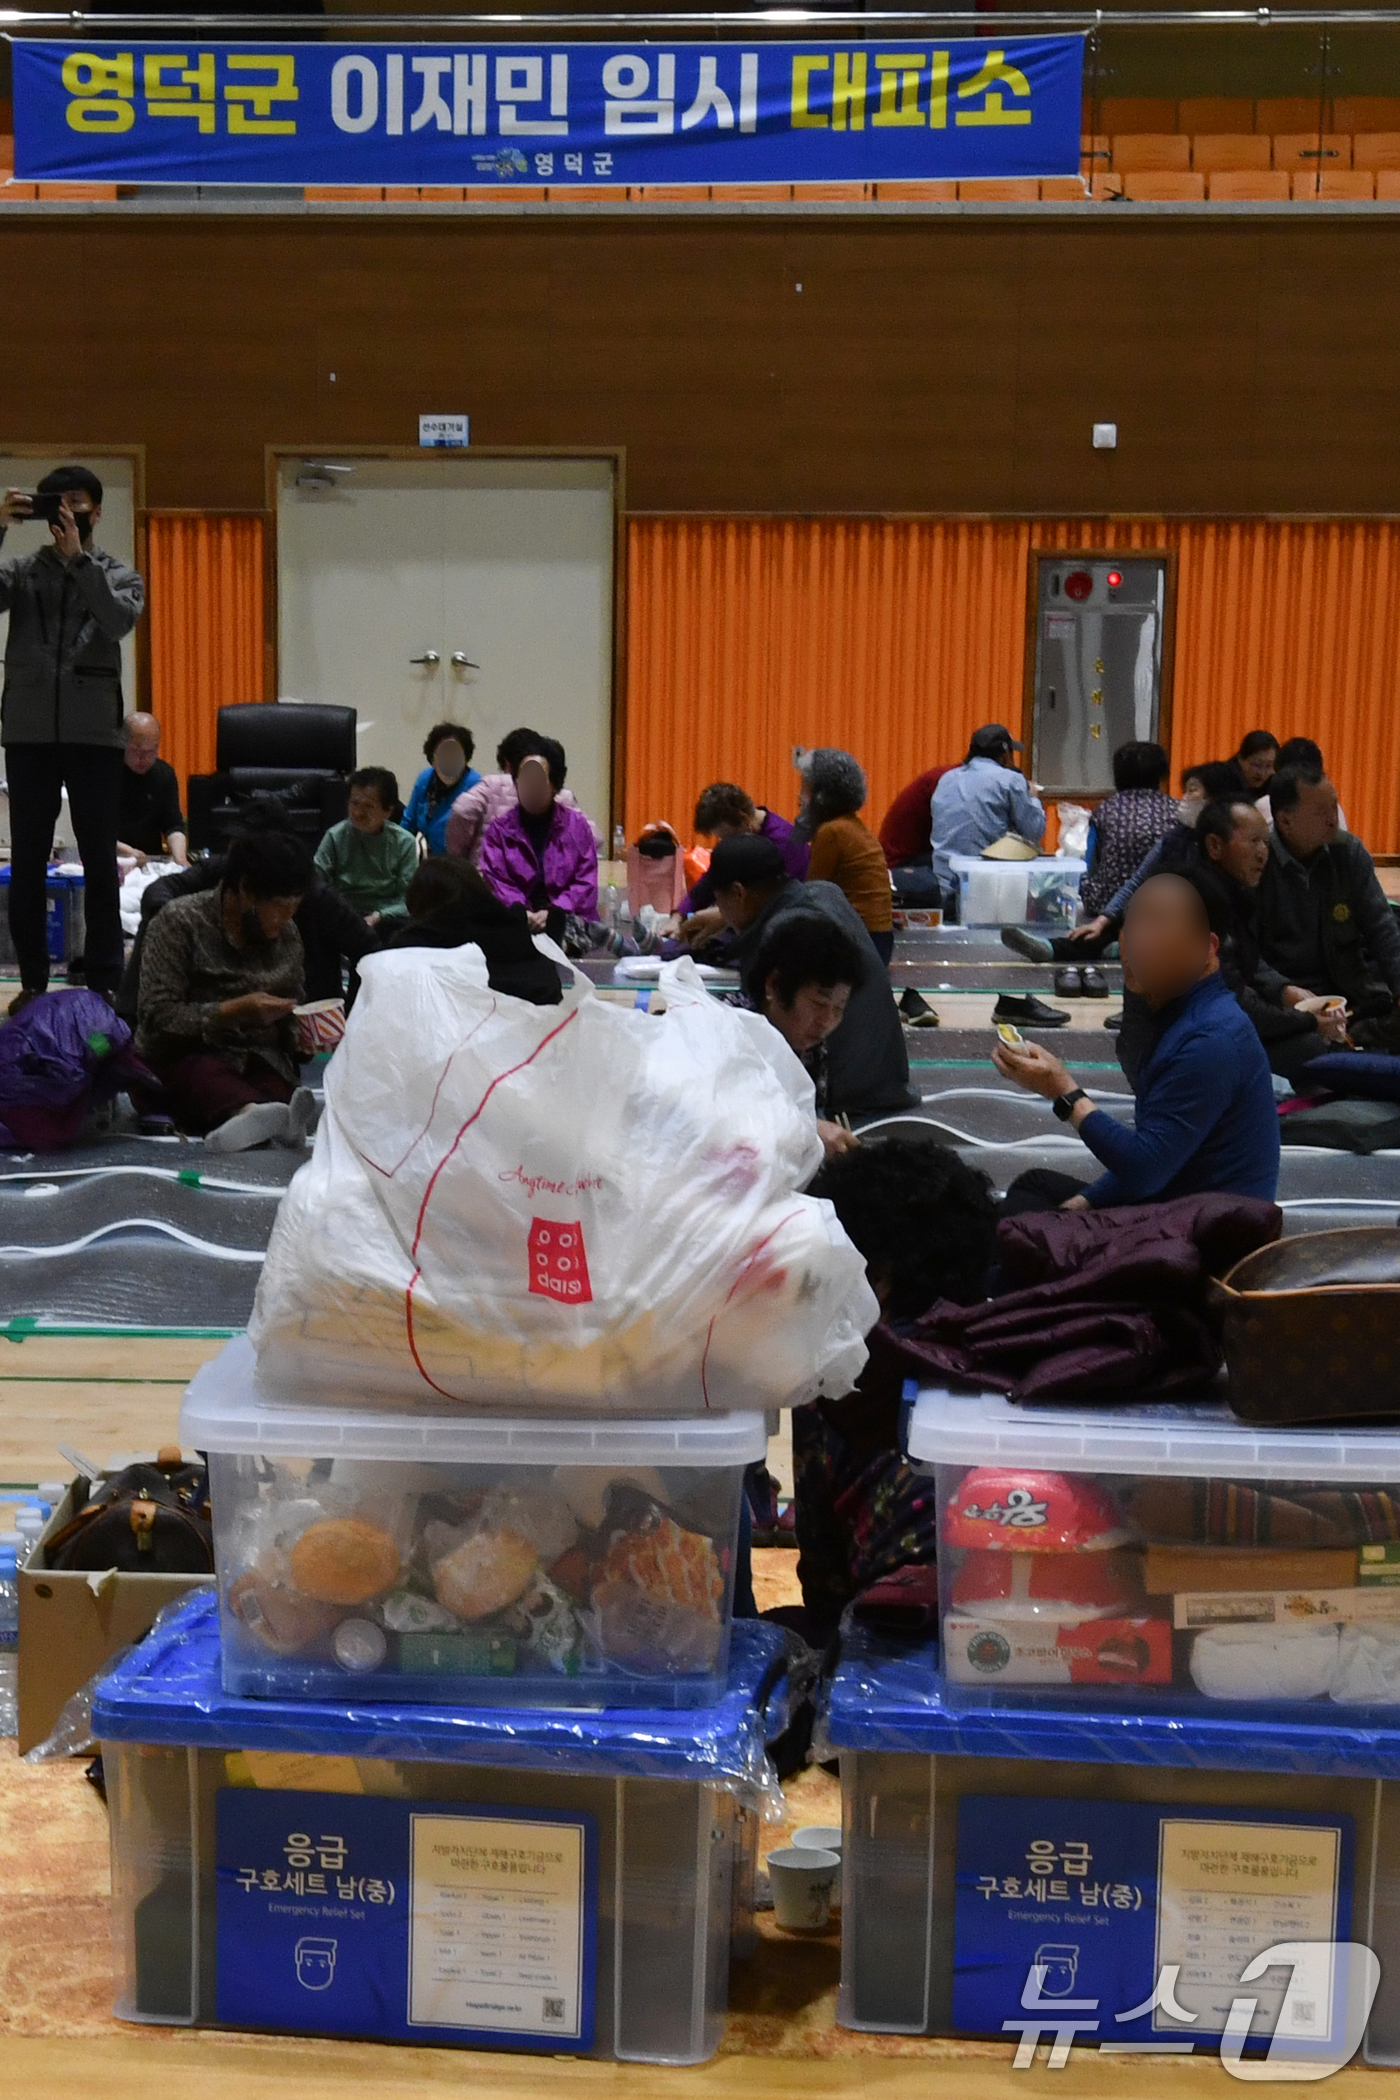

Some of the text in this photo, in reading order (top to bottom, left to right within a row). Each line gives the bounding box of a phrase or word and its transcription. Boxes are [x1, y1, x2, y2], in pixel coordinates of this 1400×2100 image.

[61, 50, 1032, 136] 영덕군 이재민 임시 대피소
[534, 152, 614, 176] 영덕군
[283, 1832, 349, 1870] 응급
[1025, 1839, 1093, 1876] 응급
[236, 1868, 396, 1906] 구호세트 남(중)
[976, 1875, 1143, 1912] 구호세트 남(중)
[268, 1903, 320, 1918] Emergency
[322, 1906, 348, 1918] Relief
[1008, 1909, 1061, 1924] Emergency
[1064, 1913, 1091, 1925] Relief
